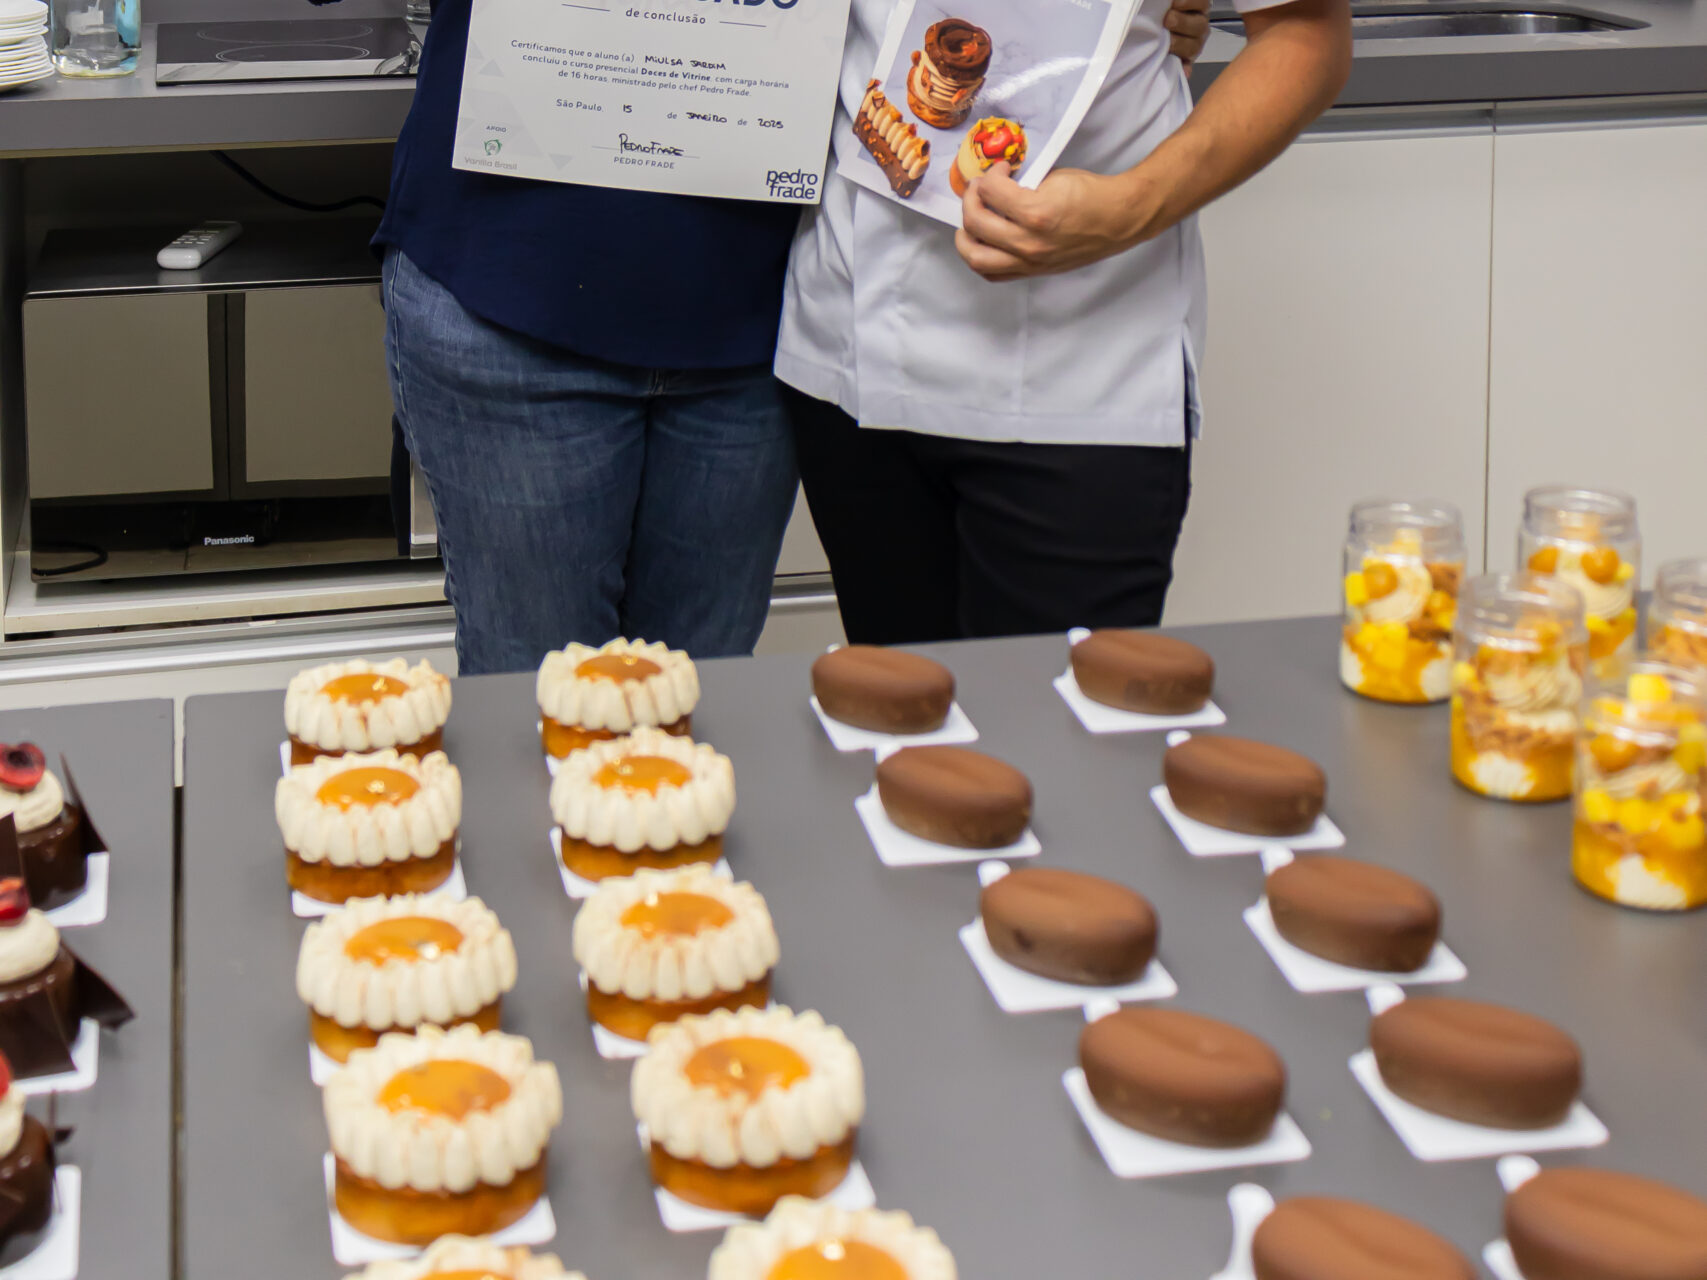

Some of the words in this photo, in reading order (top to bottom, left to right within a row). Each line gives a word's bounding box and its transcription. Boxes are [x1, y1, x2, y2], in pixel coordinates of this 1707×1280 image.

[625, 8, 640, 18] de
[644, 11, 706, 25] conclusão
[511, 39, 567, 54] Certificamos
[568, 48, 585, 57] que
[594, 50, 620, 61] aluno
[621, 53, 635, 63] (a)
[522, 54, 560, 66] concluiu
[569, 61, 594, 70] curso
[595, 63, 639, 76] presencial
[641, 67, 667, 78] Doces
[669, 70, 680, 79] de
[715, 76, 733, 84] com
[734, 78, 758, 87] carga
[760, 79, 790, 90] horária
[558, 69, 569, 78] de
[571, 70, 582, 80] 16
[611, 77, 657, 88] ministrado
[658, 81, 677, 90] pelo
[679, 83, 698, 92] chef
[700, 84, 725, 95] Pedro
[556, 98, 574, 109] São
[666, 112, 678, 120] de
[737, 119, 748, 127] de
[757, 118, 784, 129] 2025
[464, 156, 493, 167] Vanilla
[613, 156, 644, 166] PEDRO
[645, 160, 676, 170] FRADE
[766, 169, 818, 186] pedro
[769, 180, 816, 200] frade
[204, 534, 255, 546] Panasonic
